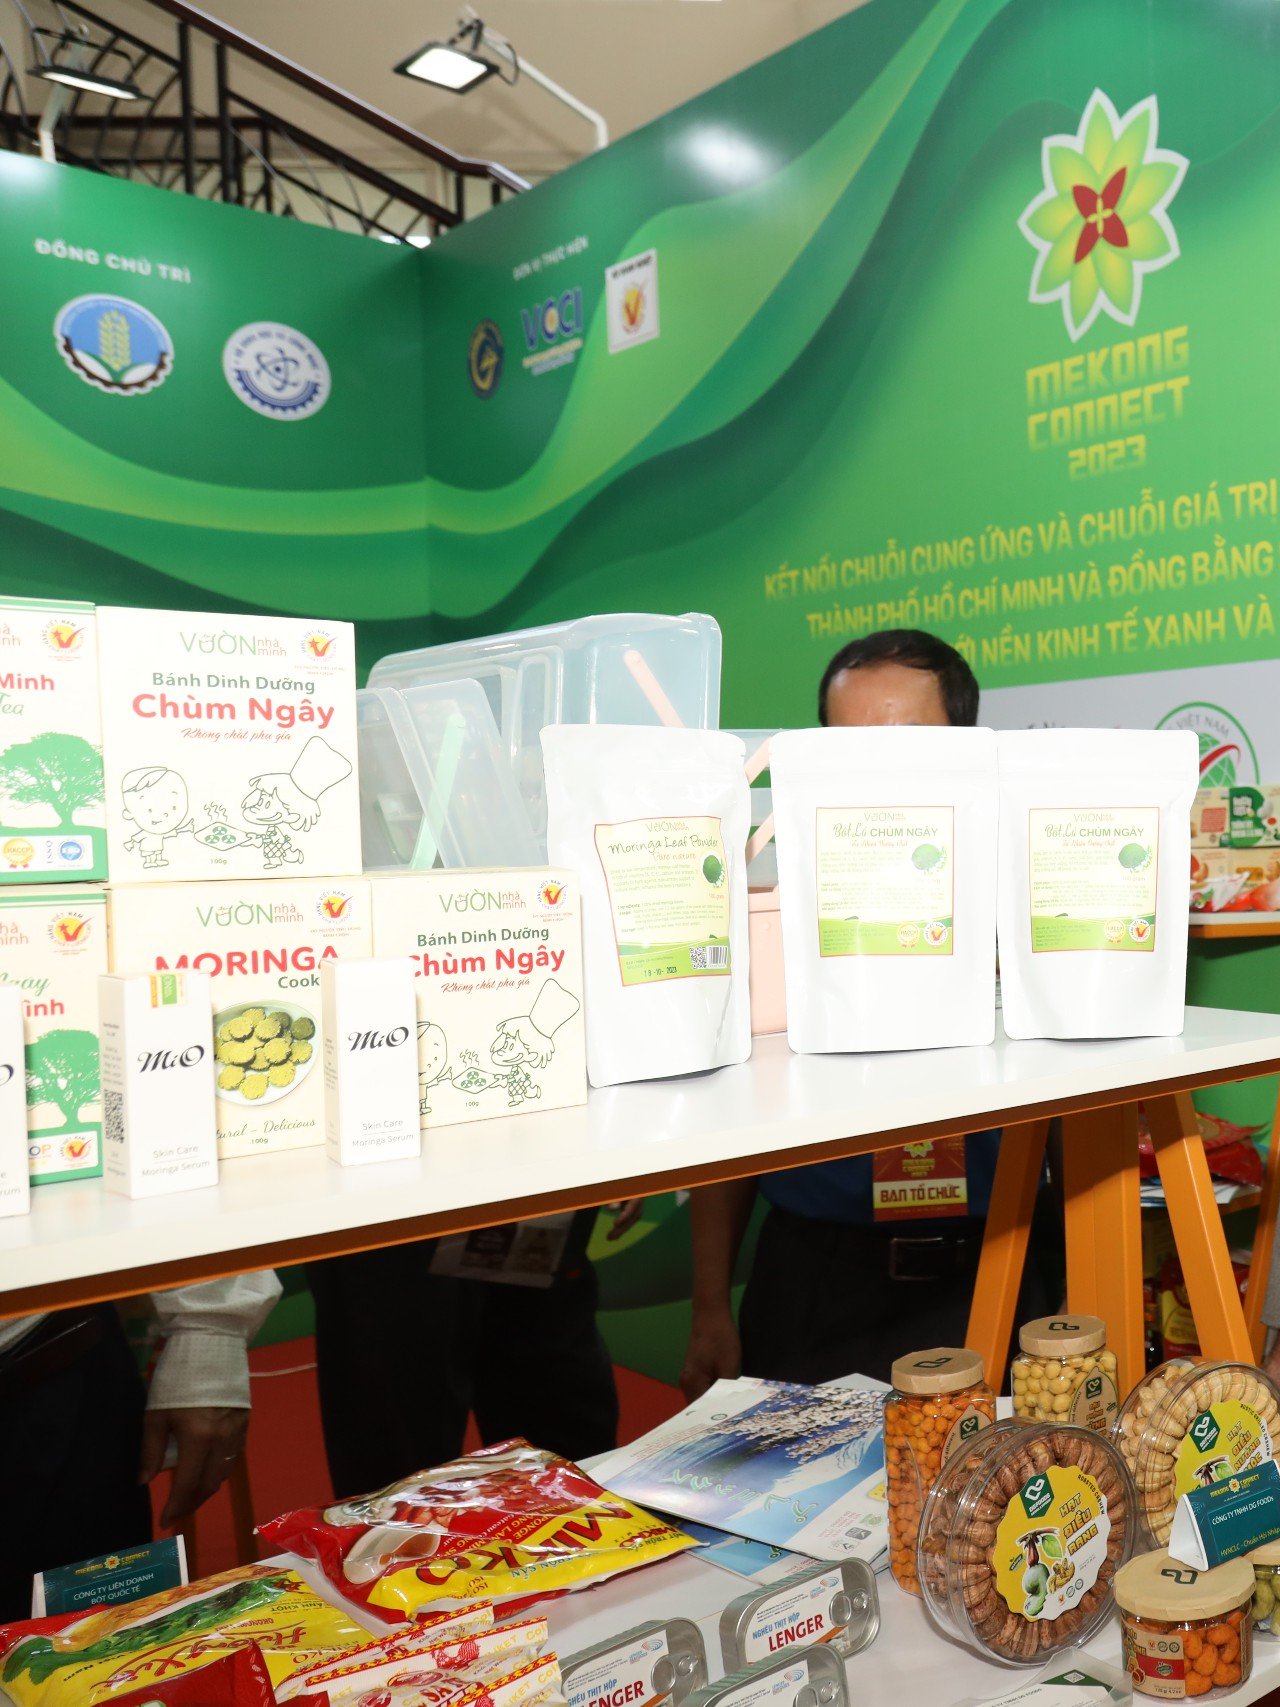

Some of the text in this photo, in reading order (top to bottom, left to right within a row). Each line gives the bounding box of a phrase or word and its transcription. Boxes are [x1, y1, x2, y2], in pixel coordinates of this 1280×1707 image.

[1026, 325, 1189, 408] MEKONG
[1027, 375, 1190, 451] CONNECT
[1068, 433, 1147, 481] 2023
[765, 561, 800, 599] KẾT
[802, 553, 837, 592] NỐI
[841, 538, 906, 588] CHUỖI
[911, 536, 975, 575] CUNG
[980, 524, 1034, 561] ỨNG
[1038, 510, 1072, 554] VÀ
[1077, 487, 1166, 547] CHUỖI
[1173, 481, 1222, 530] GIÁ
[1229, 477, 1278, 525] TRỊ
[807, 602, 874, 639] THÀNH
[877, 586, 920, 628] PHỐ
[923, 580, 955, 623] HỒ
[959, 576, 998, 619] CHÍ
[1001, 573, 1065, 612] MINH
[1069, 560, 1102, 598] VÀ
[1108, 548, 1185, 599] ĐỒNG
[1192, 533, 1274, 585] BẰNG
[982, 624, 1032, 670] NỀN
[1037, 633, 1100, 664] KINH
[1105, 606, 1138, 654] TẾ
[1144, 607, 1226, 651] XANH
[1234, 594, 1275, 641] VÀ
[152, 672, 316, 695] Bánh Dinh Dưỡng
[132, 693, 335, 730] Chùm Ngây
[181, 728, 222, 742] Không
[608, 834, 719, 854] Moringa Leaf Powder
[672, 851, 697, 860] nature
[0, 922, 18, 934] hà
[417, 926, 549, 947] Bánh Dinh Dưỡng
[155, 945, 339, 978] MORINGA
[495, 945, 565, 975] Ngây
[277, 974, 320, 990] Cook
[441, 982, 473, 994] Không
[23, 999, 65, 1017] ình
[215, 1115, 316, 1141] tural Delicious
[362, 1119, 404, 1131] Skin Care
[352, 1133, 414, 1148] Moringa Serum
[152, 1145, 199, 1159] Skin Care
[141, 1160, 210, 1177] Moringa Serum
[880, 1189, 907, 1203] BAN
[910, 1183, 925, 1200] TỔ
[1078, 1475, 1096, 1493] ROASTED
[1059, 1493, 1082, 1517] HẠT
[1212, 1514, 1228, 1525] CÔNG
[1227, 1511, 1235, 1519] TY
[1234, 1505, 1249, 1516] TNHH
[1249, 1502, 1256, 1511] DG
[1067, 1523, 1098, 1556] RANG
[74, 1589, 96, 1600] CÔNG
[108, 1581, 125, 1591] LIÊN
[126, 1573, 154, 1586] DOANH
[108, 1587, 130, 1600] QUỐC
[774, 1618, 787, 1630] THỊT
[787, 1611, 800, 1623] HỘP
[768, 1614, 824, 1652] LENGER
[581, 1681, 645, 1707] ENGER
[587, 1679, 618, 1698] THỊT HỘP
